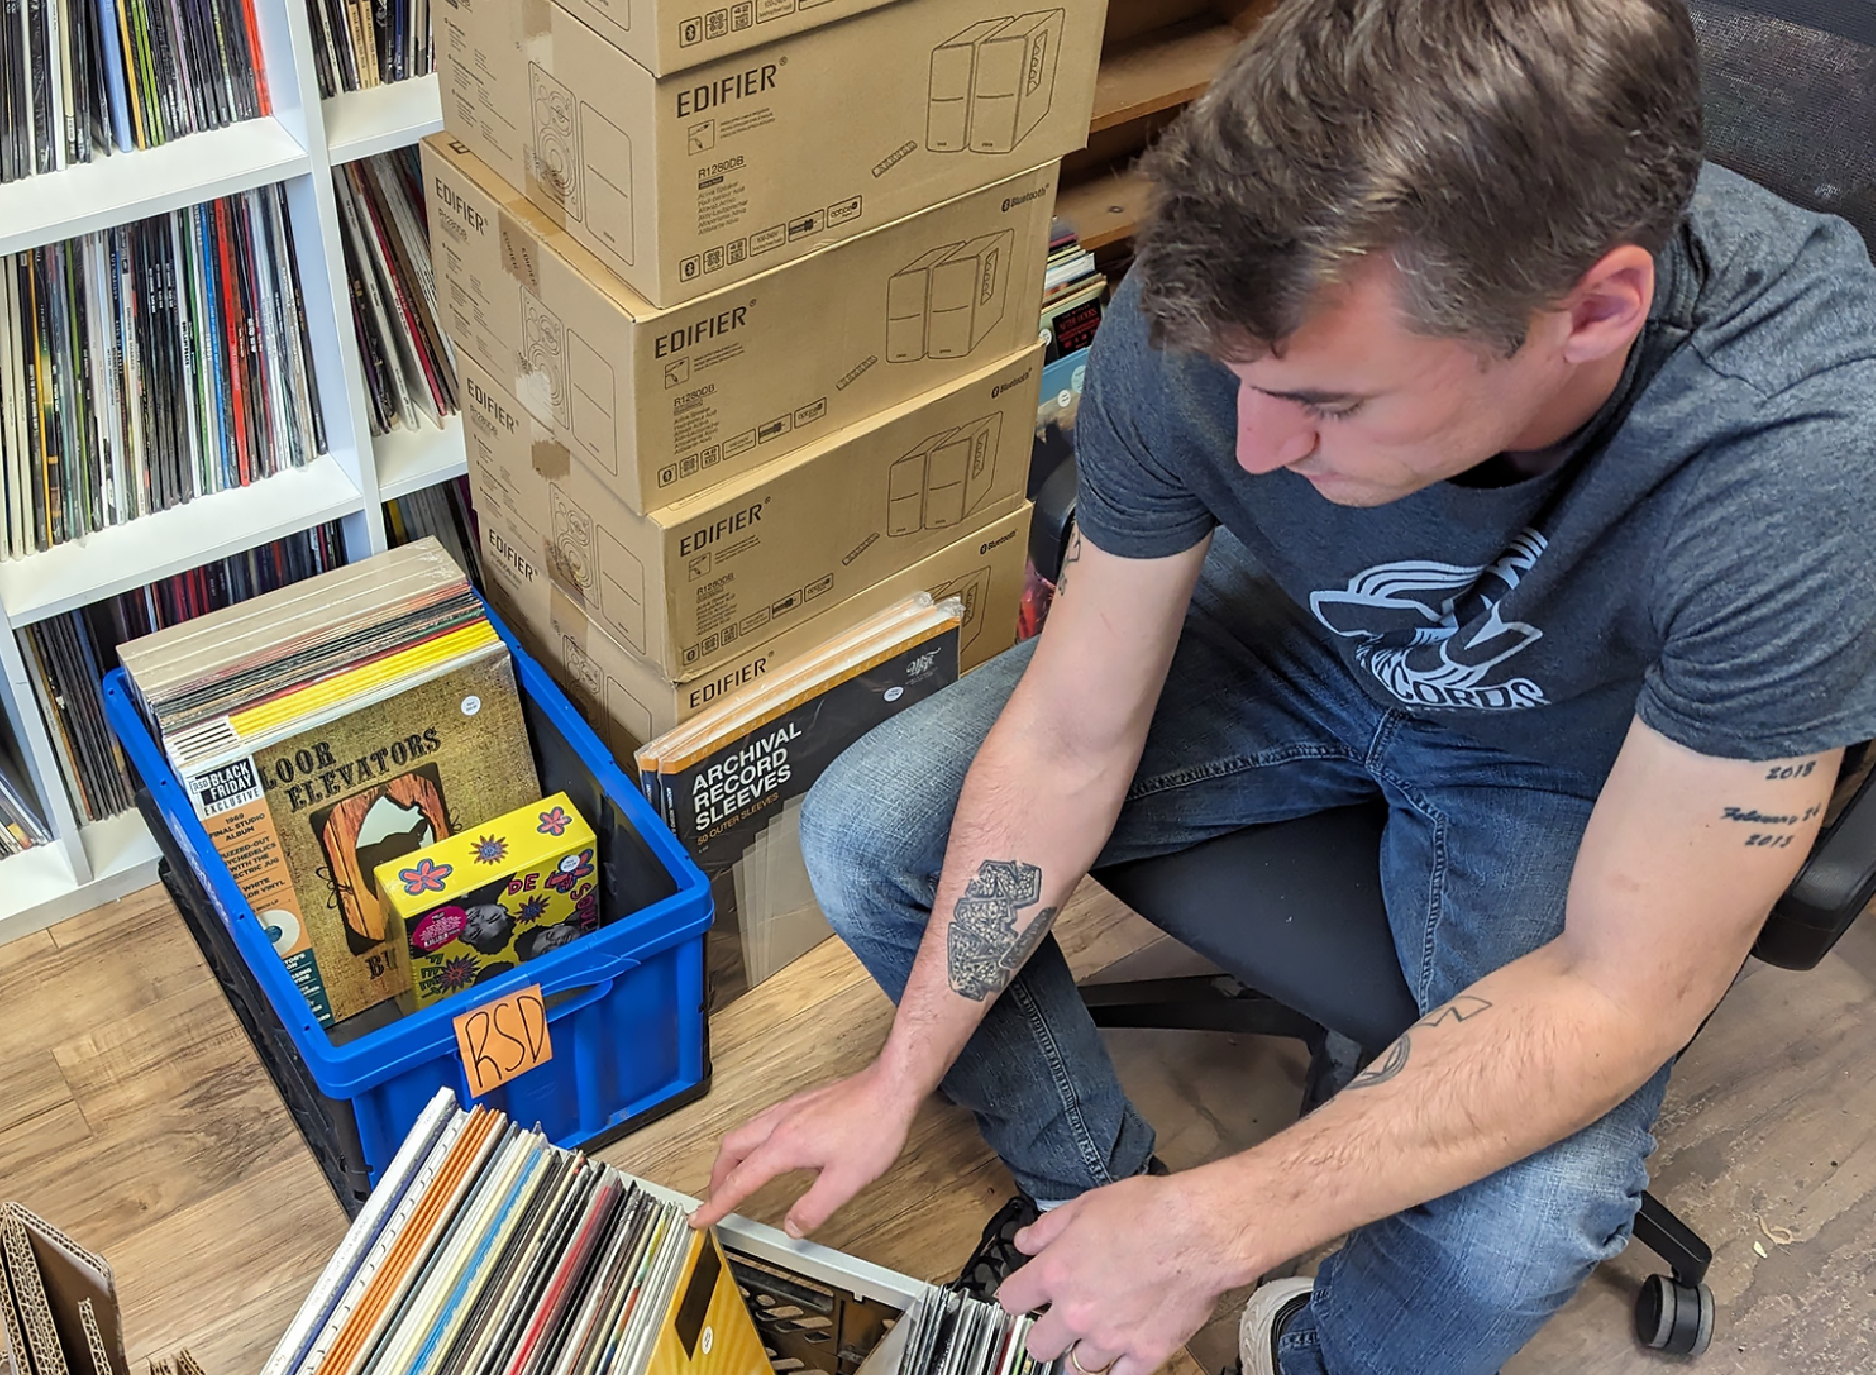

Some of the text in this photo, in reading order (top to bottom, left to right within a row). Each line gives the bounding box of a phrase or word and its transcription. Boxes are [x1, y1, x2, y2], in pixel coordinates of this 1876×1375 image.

[676, 64, 777, 119] EDIFIER
[435, 176, 485, 236] EDIFIER
[655, 305, 747, 359] EDIFIER
[466, 377, 515, 435] EDIFIER
[489, 528, 533, 583] EDIFIER
[679, 503, 763, 558] EDIFIER
[689, 657, 767, 709] EDIFIER
[210, 761, 249, 787] BLACK
[284, 727, 442, 813] ELEVATORS
[693, 721, 802, 795] ARCHIVAL
[694, 747, 788, 813] RECORD
[203, 787, 260, 817] EXCLUSIVE
[210, 773, 252, 801] FRIDAY
[695, 764, 791, 831] SLEEVES
[225, 825, 255, 841] ALBUM
[709, 815, 741, 838] OUTER
[740, 792, 780, 820] SLEEVES
[507, 872, 541, 897] DE
[465, 995, 545, 1089] RSD
